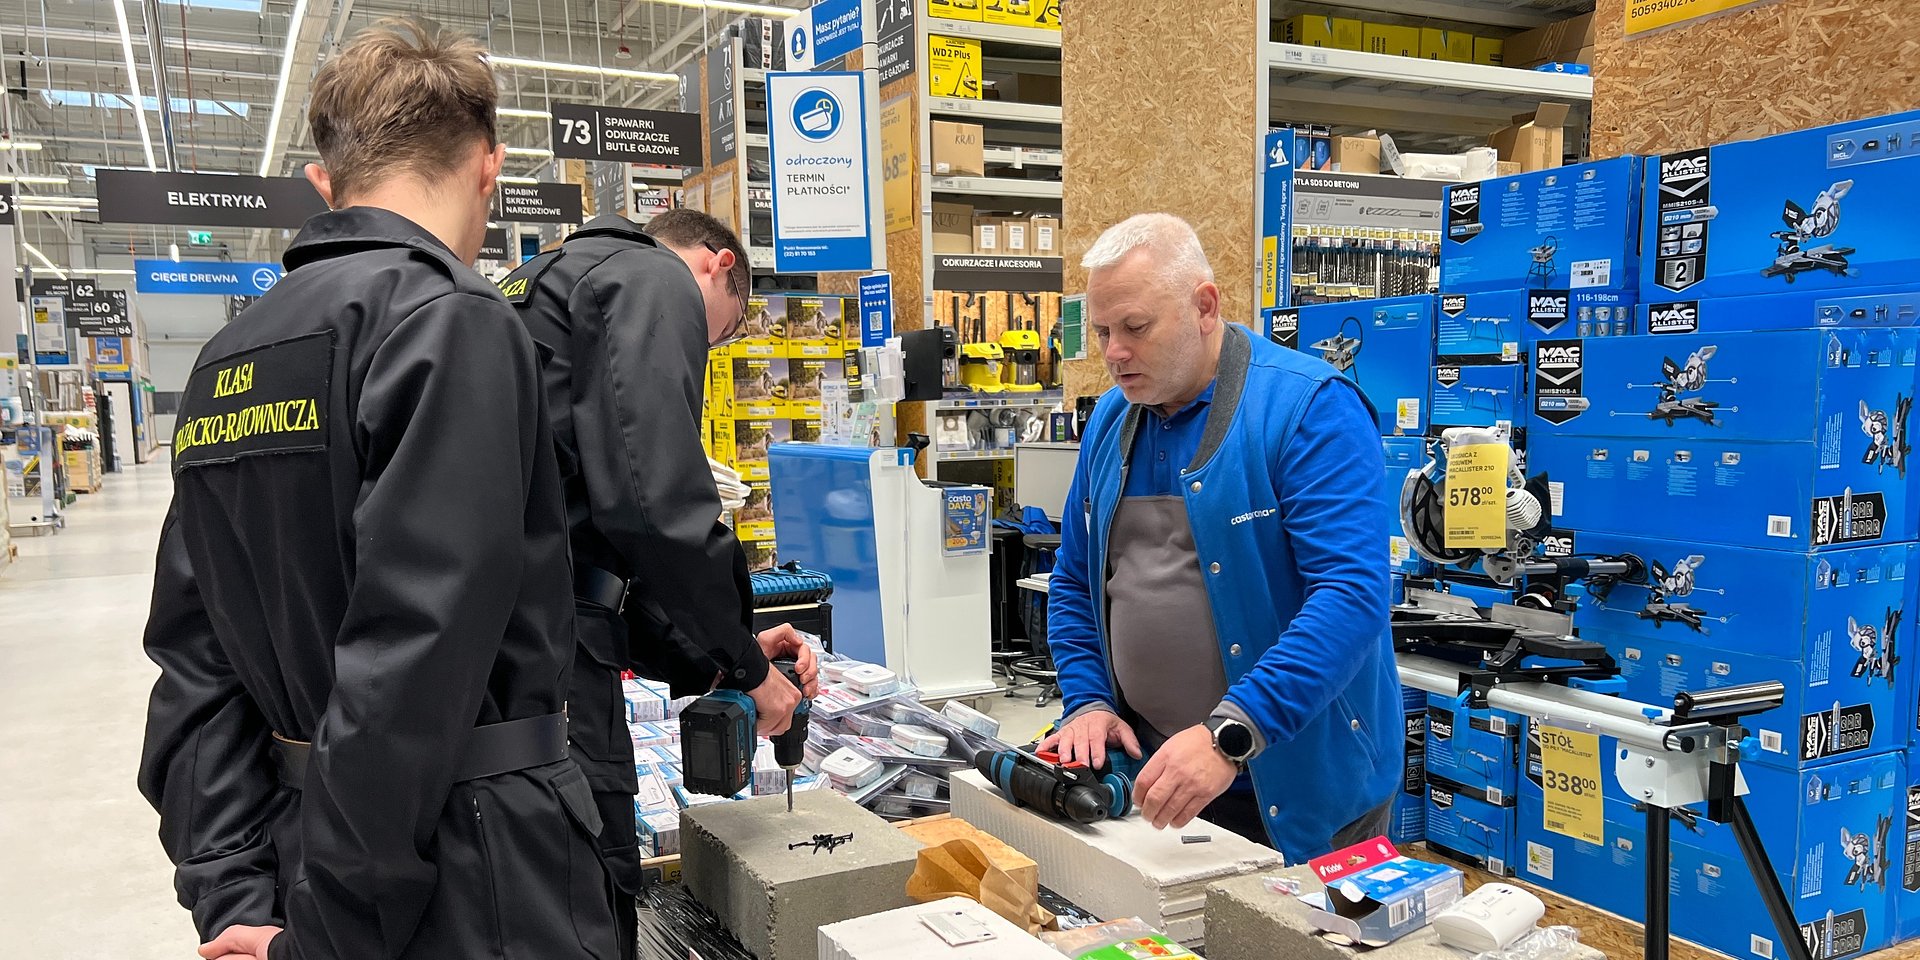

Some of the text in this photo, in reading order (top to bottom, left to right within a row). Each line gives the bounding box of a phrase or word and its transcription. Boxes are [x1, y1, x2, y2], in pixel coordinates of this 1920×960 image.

[815, 6, 860, 36] Masz pytanie?
[838, 26, 847, 37] JEST
[723, 45, 732, 67] 71
[932, 47, 971, 60] WD 2 Plus
[604, 117, 655, 130] SPAWARKI
[558, 118, 592, 145] 73
[605, 130, 670, 143] ODKURZACZE
[605, 142, 680, 156] BUTLE GAZOWE
[785, 153, 853, 168] odroczony
[1661, 155, 1707, 174] MAC
[786, 173, 825, 183] TERMIN
[1662, 166, 1707, 179] ALLISTER
[1311, 179, 1323, 188] SDS
[1324, 179, 1333, 188] DO
[1334, 180, 1360, 190] BETONU
[504, 187, 539, 197] DRABINY
[1450, 187, 1479, 200] MAC
[167, 191, 267, 209] ELEKTRYKA
[505, 197, 543, 206] SKRZYNKI
[640, 198, 660, 207] YATO
[506, 207, 561, 217] NARZĘDZIOWE
[480, 247, 504, 256] RĘTAKI
[942, 258, 1042, 269] ODKURZACZE I AKCESORIA
[151, 272, 239, 284] CIĘCIE DREWNA
[1675, 261, 1687, 283] 2
[76, 284, 95, 297] 62
[1530, 296, 1567, 308] MAC
[1576, 293, 1619, 302] 116-198cm
[93, 301, 111, 313] 60
[1272, 313, 1298, 324] MAC
[1650, 308, 1696, 322] MAC
[1651, 319, 1695, 327] ALLISTER
[1538, 346, 1581, 359] MAC
[213, 361, 254, 399] KLASA
[1449, 465, 1484, 474] MACALLISTER
[947, 494, 972, 503] casto
[1450, 486, 1493, 507] 578 00
[948, 502, 972, 510] DAYS
[1430, 720, 1452, 733] MAC
[1541, 731, 1574, 749] STÓŁ
[1545, 769, 1597, 796] 338 00
[1431, 788, 1453, 801] MAC
[1325, 862, 1344, 874] Kidde
